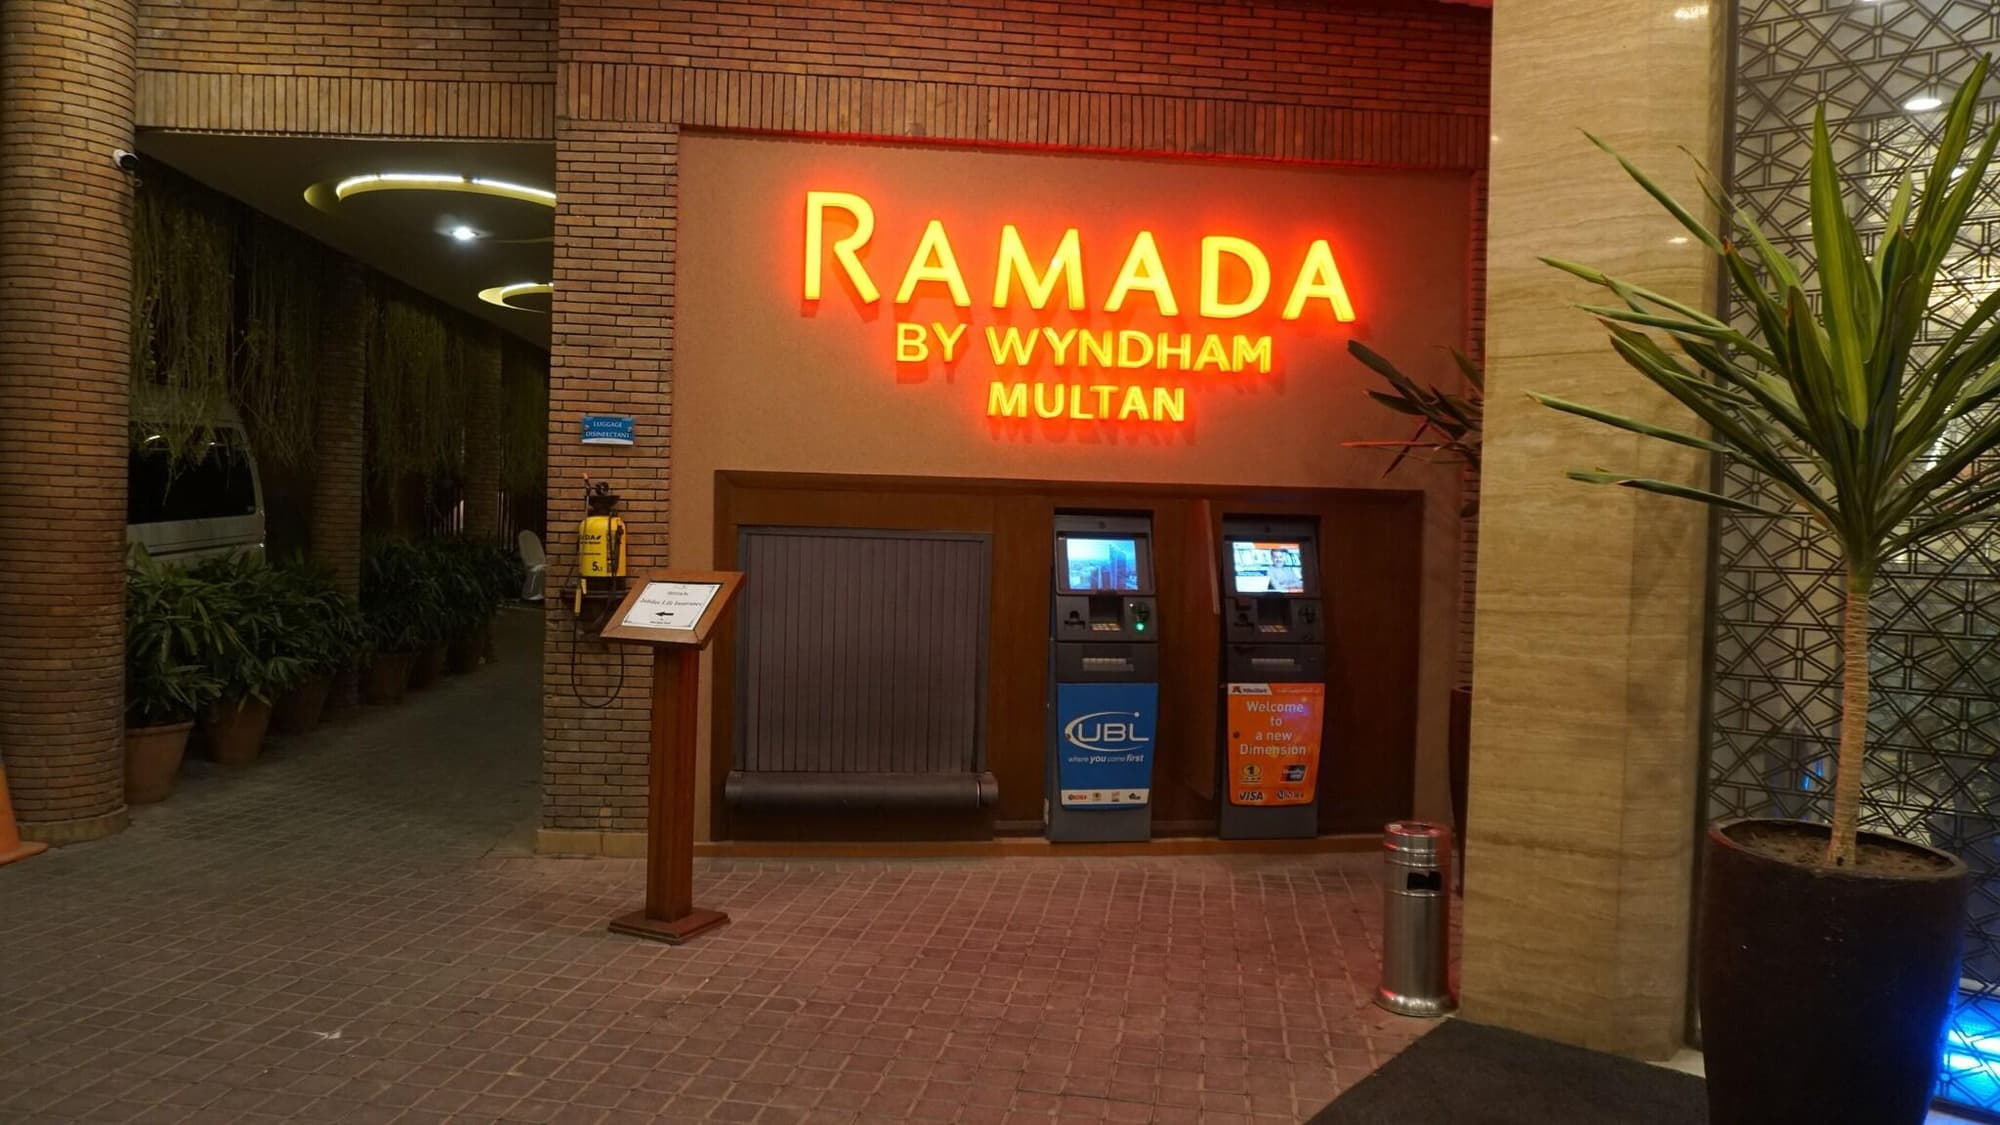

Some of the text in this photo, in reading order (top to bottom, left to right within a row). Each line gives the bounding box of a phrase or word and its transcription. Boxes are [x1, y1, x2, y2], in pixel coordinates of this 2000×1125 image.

[804, 191, 1355, 322] RAMADA
[896, 322, 1272, 373] BY WYNDHAM
[987, 381, 1185, 422] MULTAN
[1246, 701, 1304, 712] Welcome
[1270, 717, 1282, 726] to
[1078, 723, 1149, 742] UBL
[1255, 732, 1293, 741] a new
[1240, 744, 1306, 755] Dimension
[1089, 755, 1106, 764] you
[1126, 754, 1144, 762] first
[1240, 791, 1264, 801] VISA
